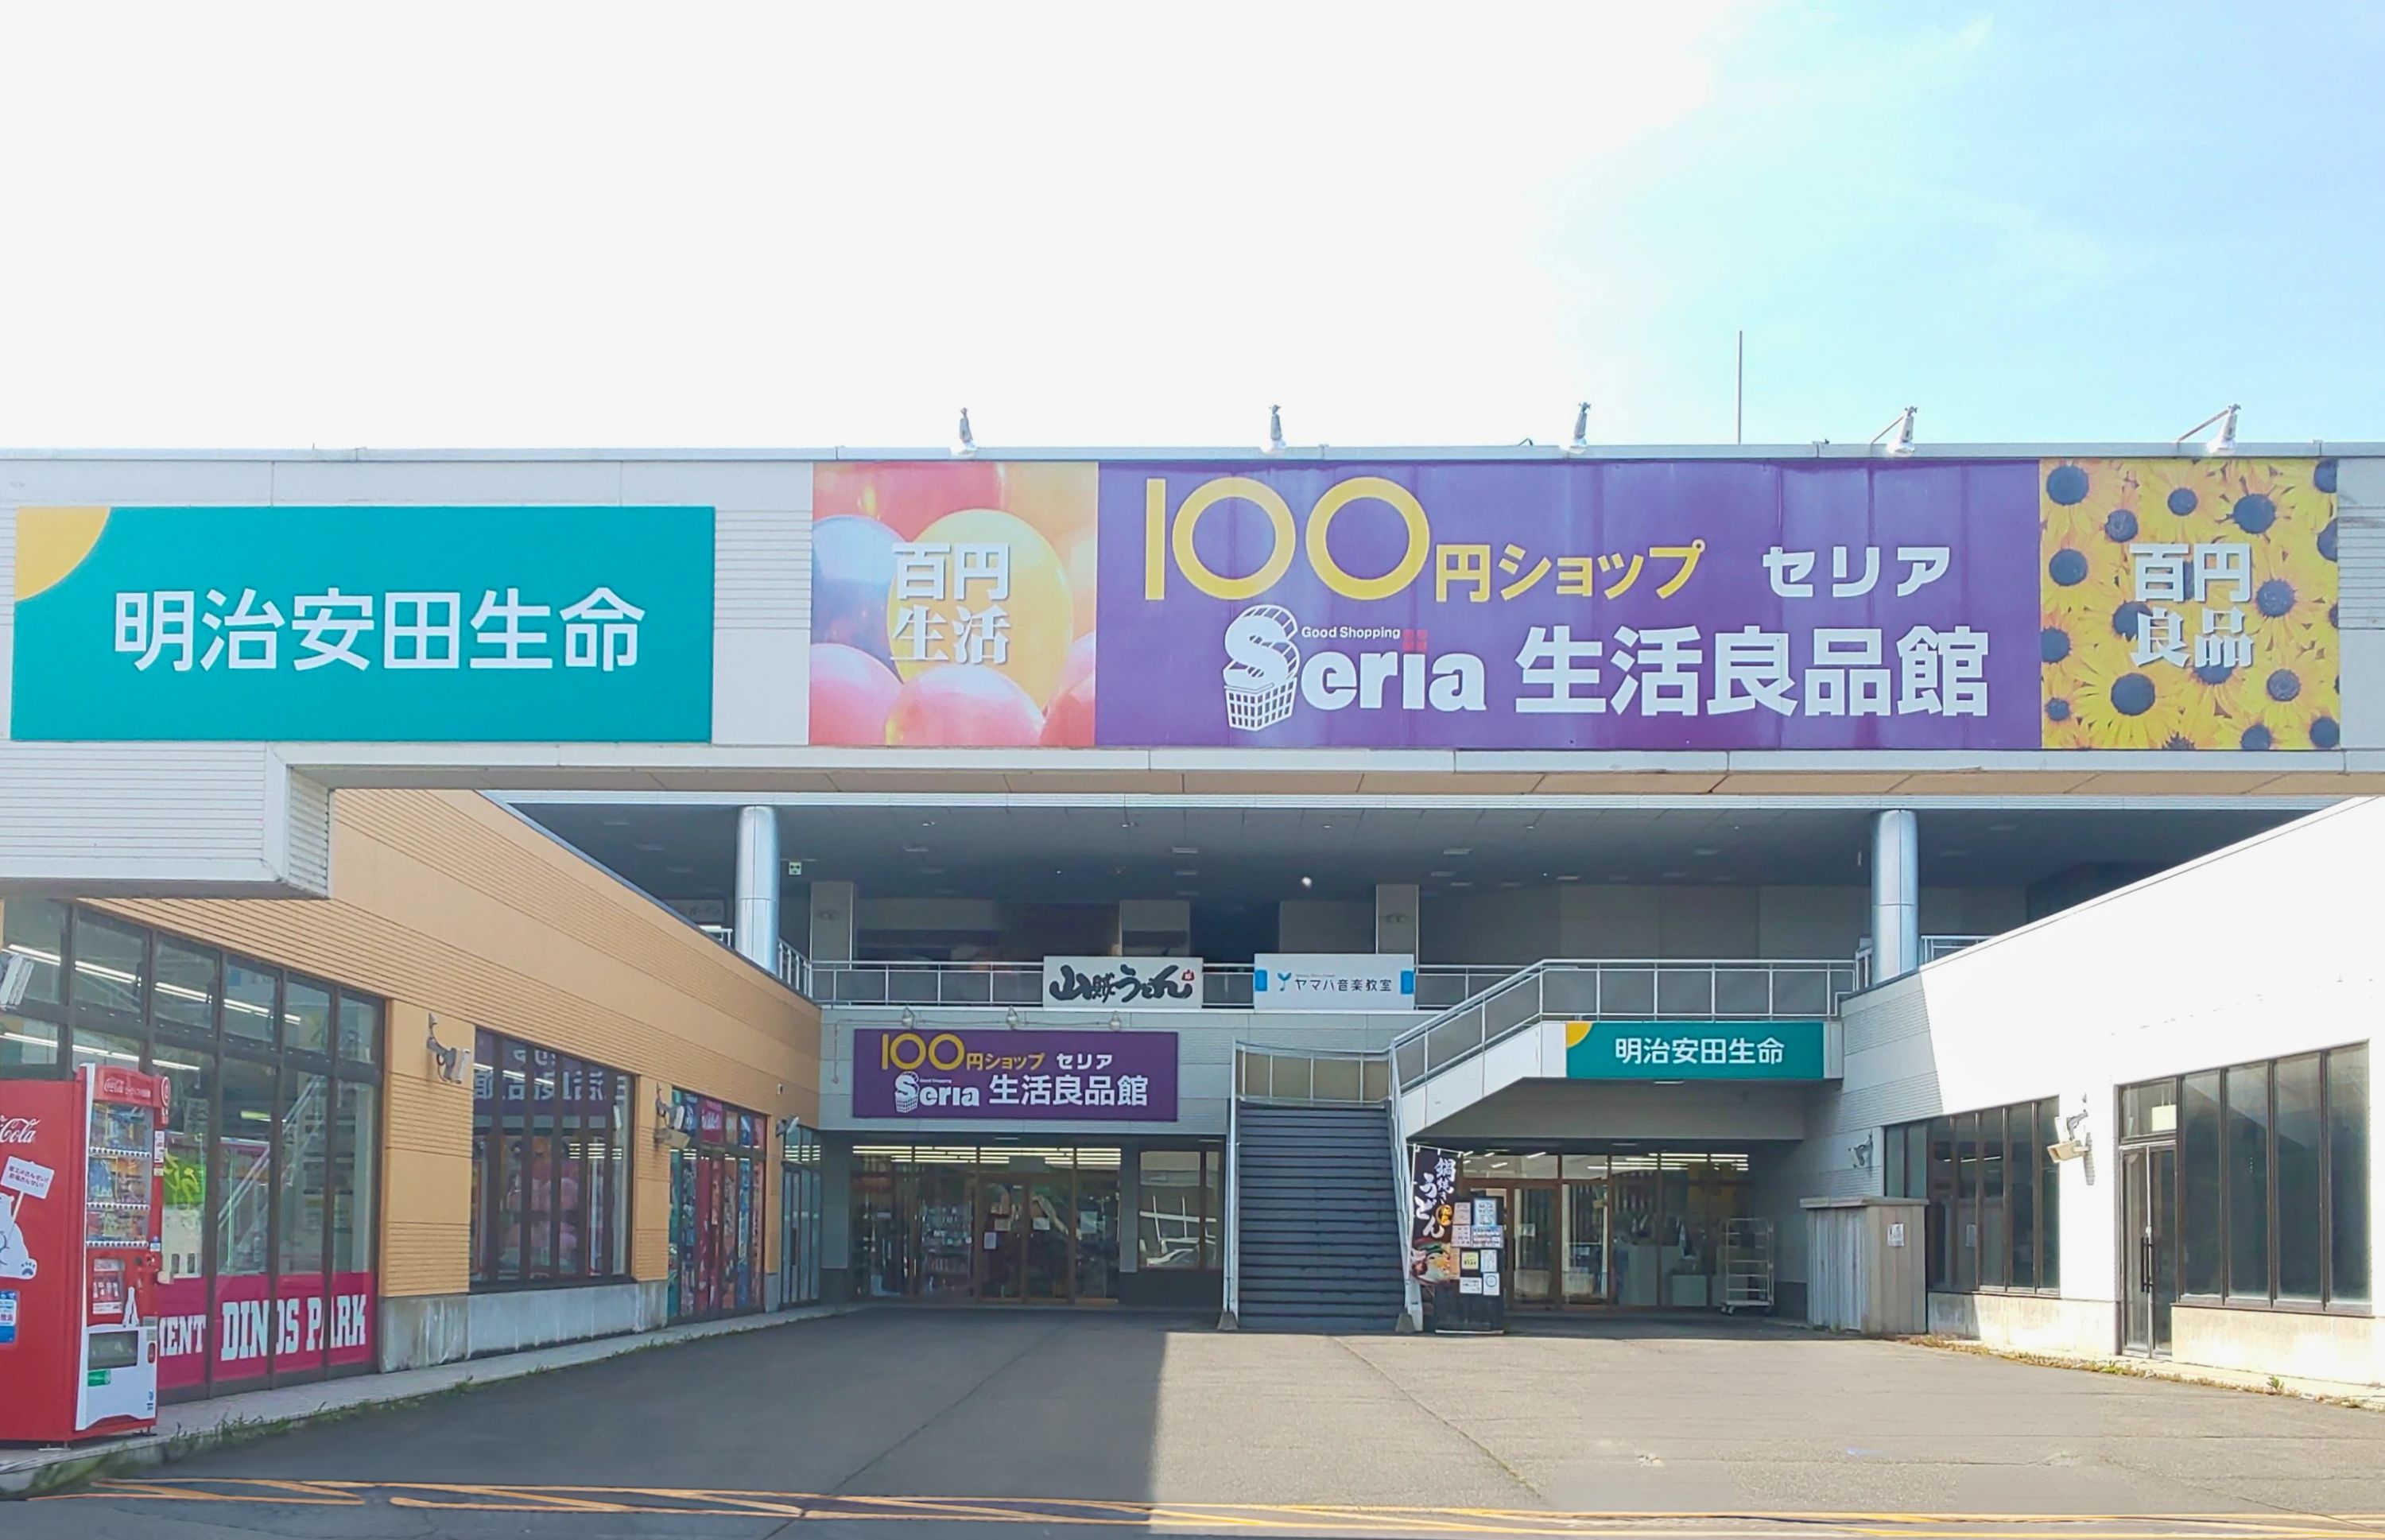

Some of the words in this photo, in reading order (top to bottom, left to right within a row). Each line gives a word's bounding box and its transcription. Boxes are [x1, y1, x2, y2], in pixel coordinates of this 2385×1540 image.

[1145, 476, 1706, 602] 100円ショップ
[1763, 546, 1950, 598] セリア
[891, 542, 1010, 601] 百円
[2130, 544, 2251, 602] 百円
[114, 588, 646, 672] 明治安田生命
[890, 604, 1010, 665] 生活
[1301, 626, 1336, 638] Good
[1340, 626, 1401, 639] Shopping
[2131, 607, 2254, 667] 良品
[1223, 605, 1487, 730] Seria
[1515, 625, 1988, 716] 生活良品館
[1295, 979, 1392, 992] ヤマハ音楽教室
[882, 1033, 1045, 1070] 100円ショップ
[1057, 1053, 1112, 1070] セリア
[1615, 1038, 1785, 1065] 明治安田生命
[894, 1072, 979, 1112] Seria
[990, 1074, 1148, 1106] 生活良品館
[1415, 1173, 1445, 1238] うどん
[306, 1294, 366, 1351] PARK
